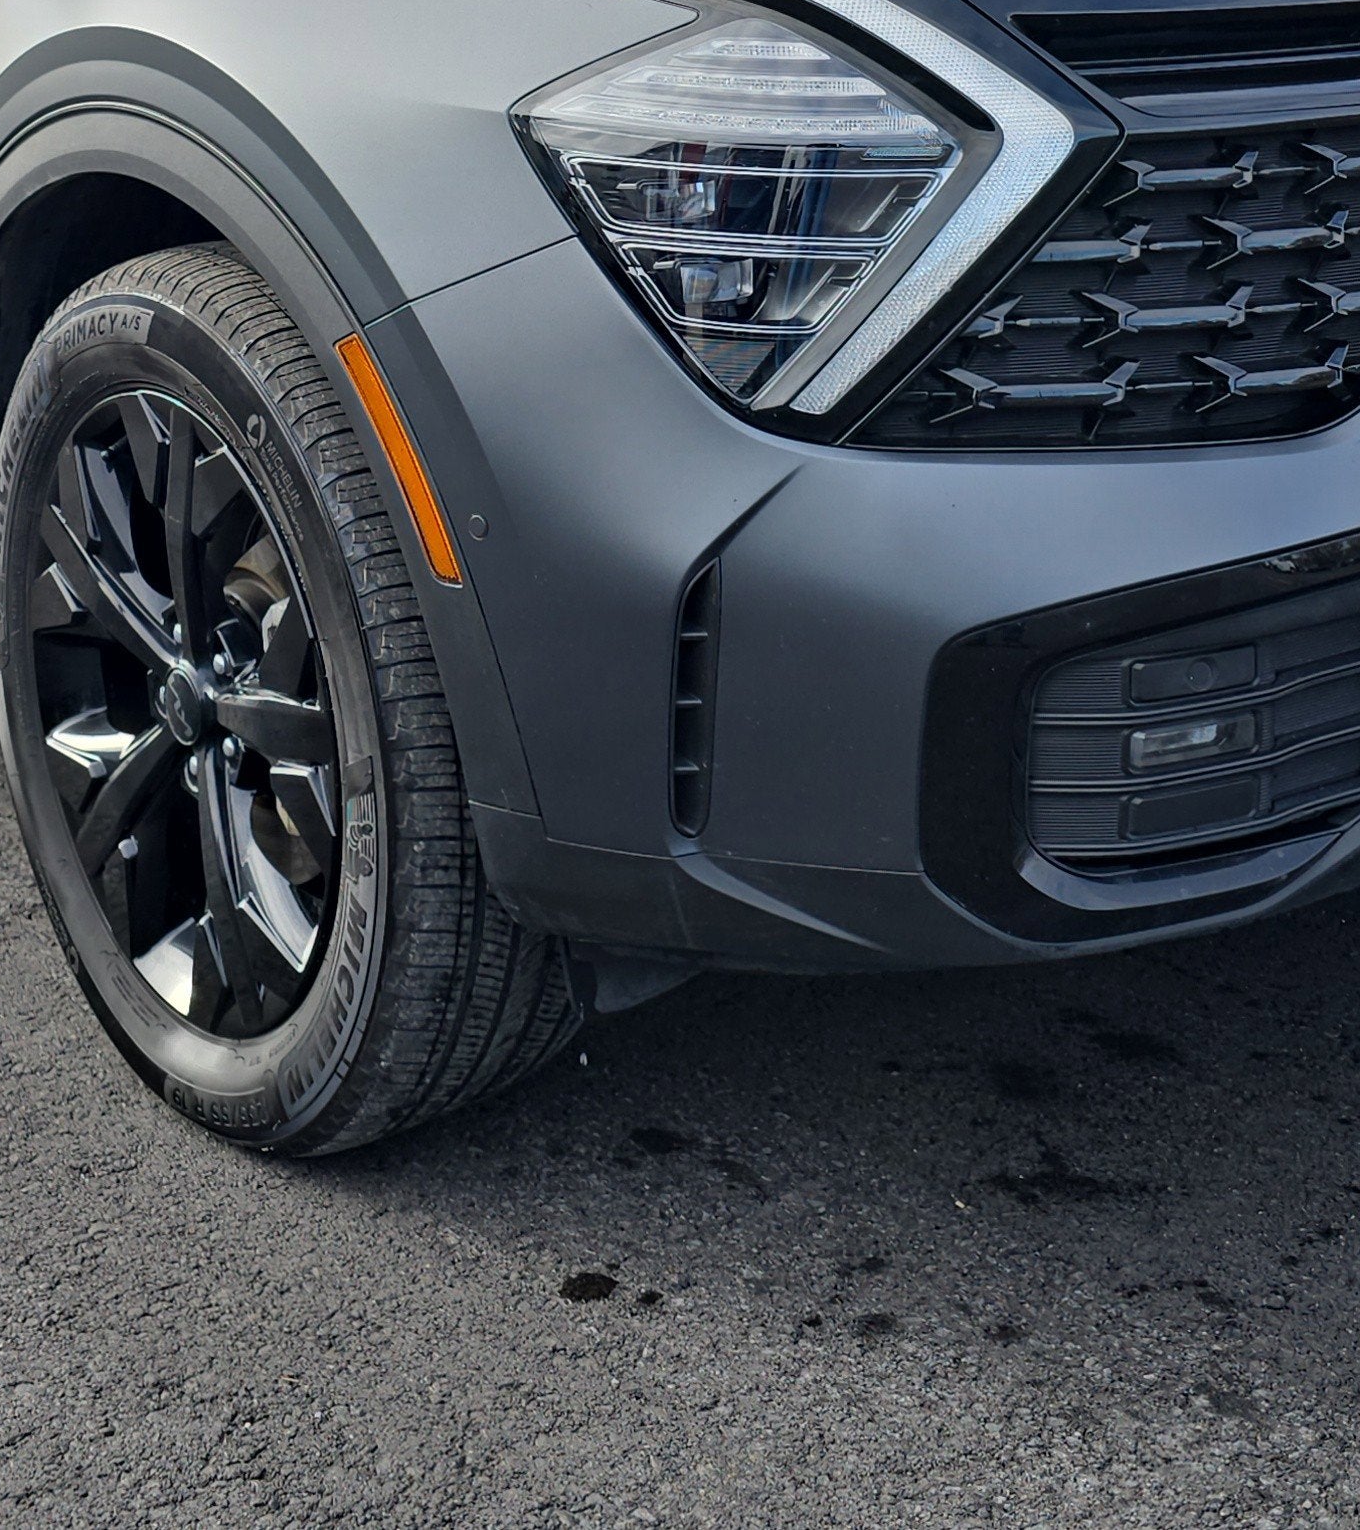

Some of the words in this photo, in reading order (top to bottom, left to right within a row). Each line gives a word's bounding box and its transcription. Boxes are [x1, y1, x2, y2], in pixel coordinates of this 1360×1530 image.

[55, 311, 122, 355] PRIMACY
[121, 315, 141, 336] A/S
[265, 441, 303, 508] MICHELIN
[286, 889, 368, 1104] MICHELIN
